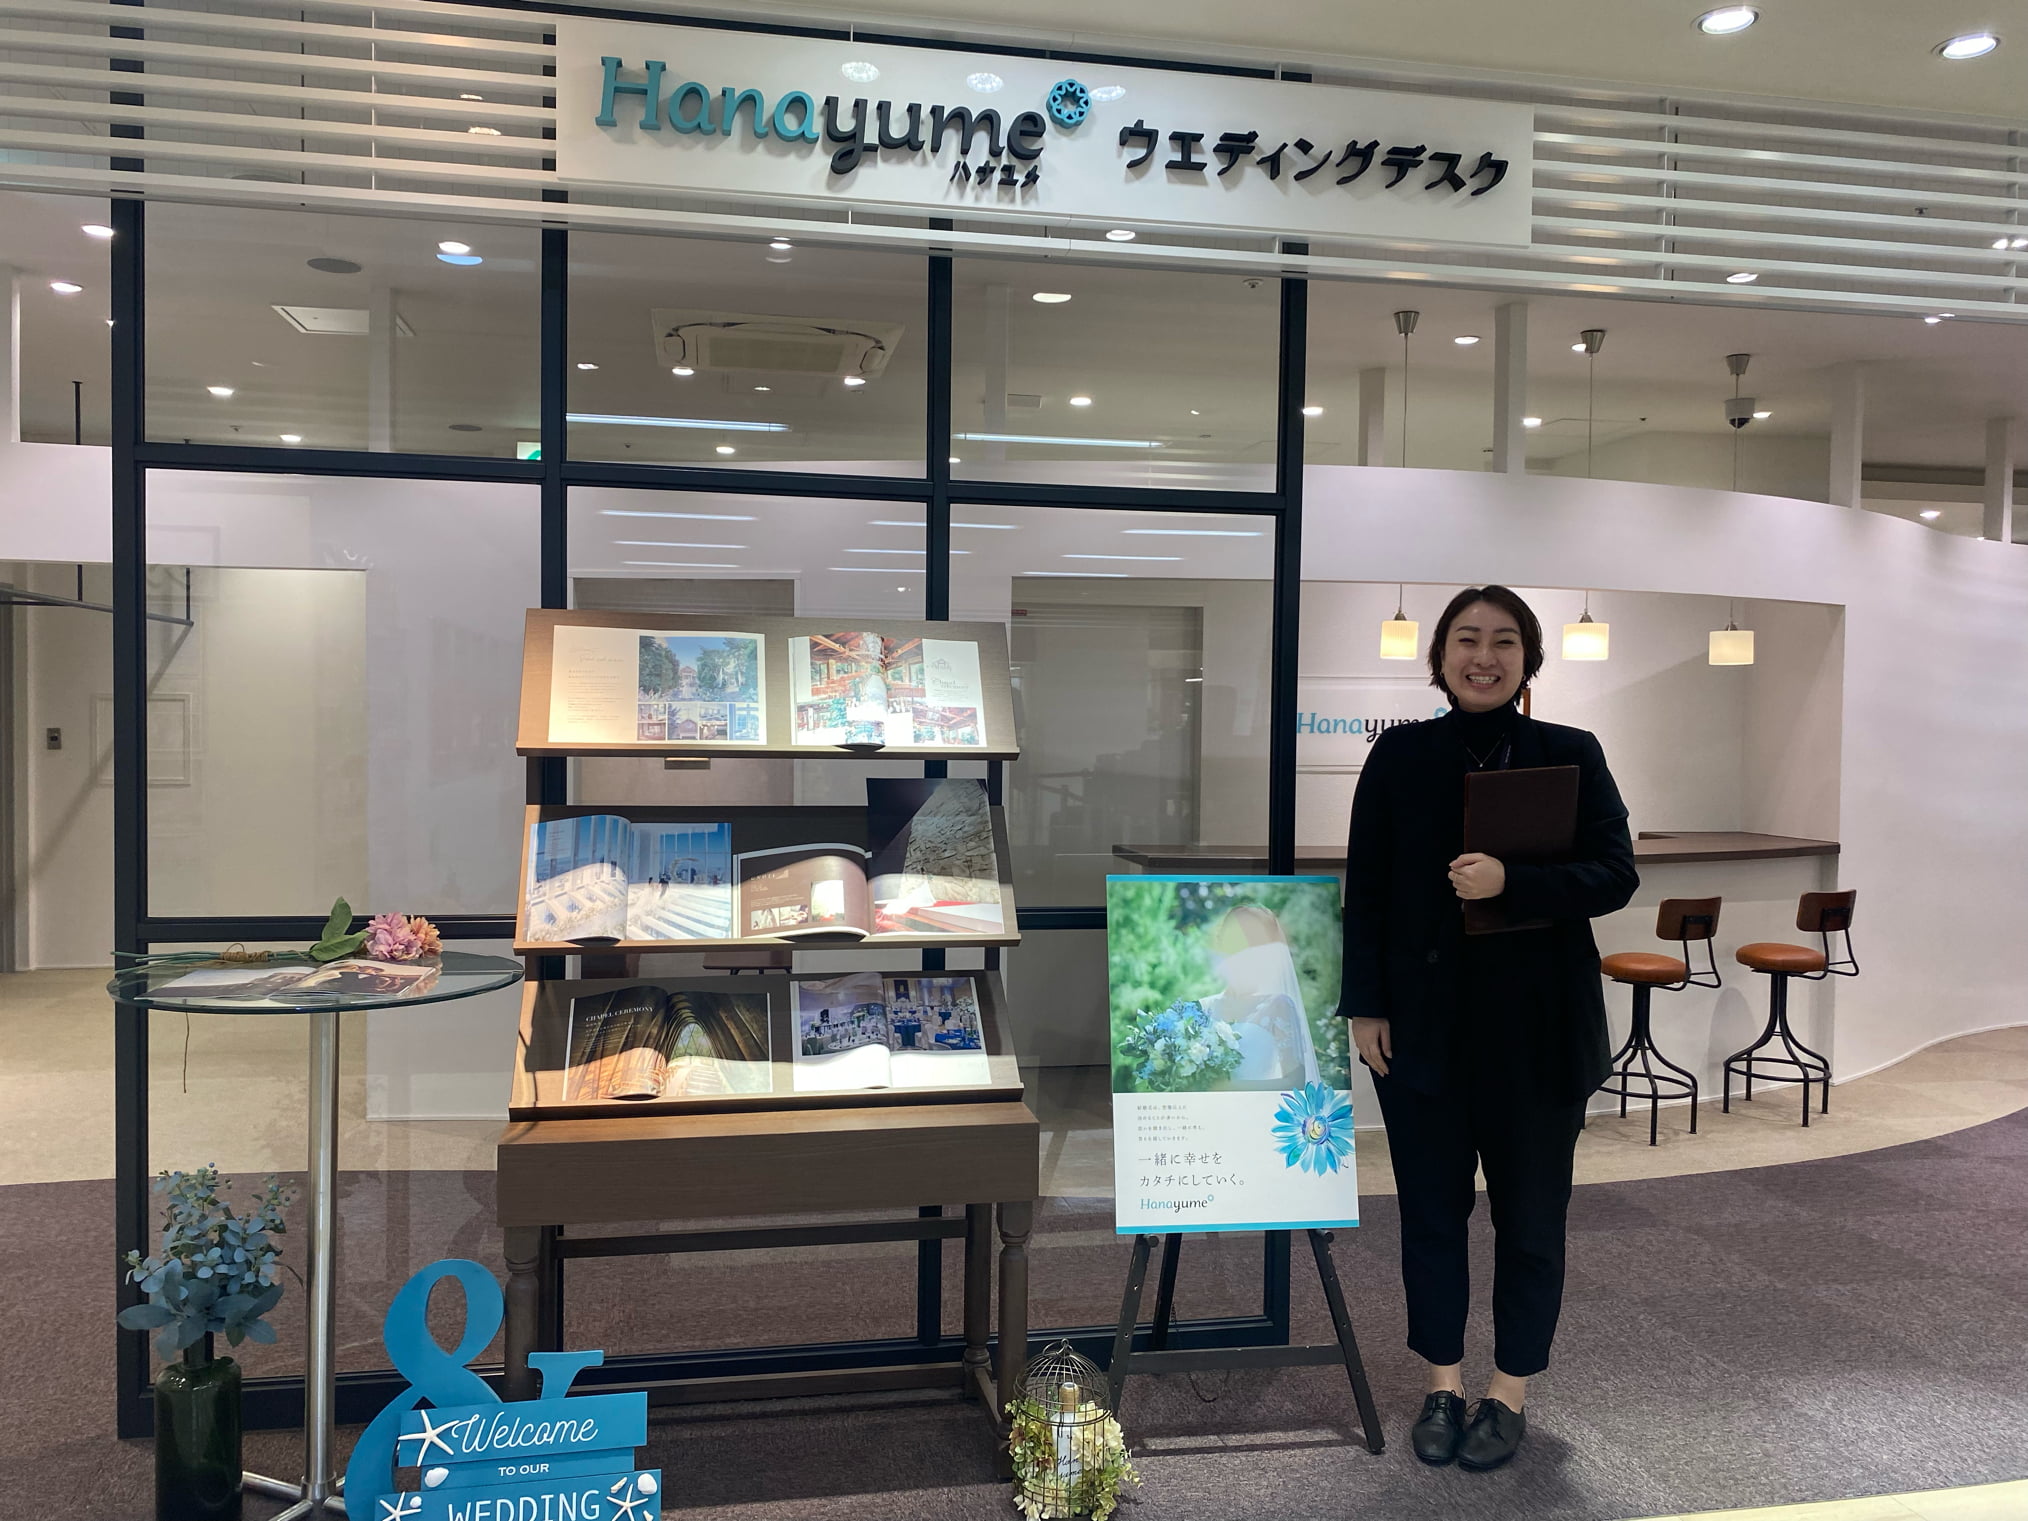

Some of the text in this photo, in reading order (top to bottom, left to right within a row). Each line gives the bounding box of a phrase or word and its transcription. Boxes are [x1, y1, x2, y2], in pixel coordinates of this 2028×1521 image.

[596, 55, 1046, 174] Hanayume
[1118, 118, 1511, 198] ウエディングデスク
[949, 160, 1041, 188] ハナユメ
[1138, 1151, 1223, 1166] 一緒に幸せを
[1140, 1173, 1245, 1188] カタチにしていく。
[1140, 1197, 1209, 1213] Hanayume
[451, 1411, 599, 1453] Welcome
[498, 1463, 550, 1476] TO OUR
[448, 1489, 600, 1521] WEDDING
